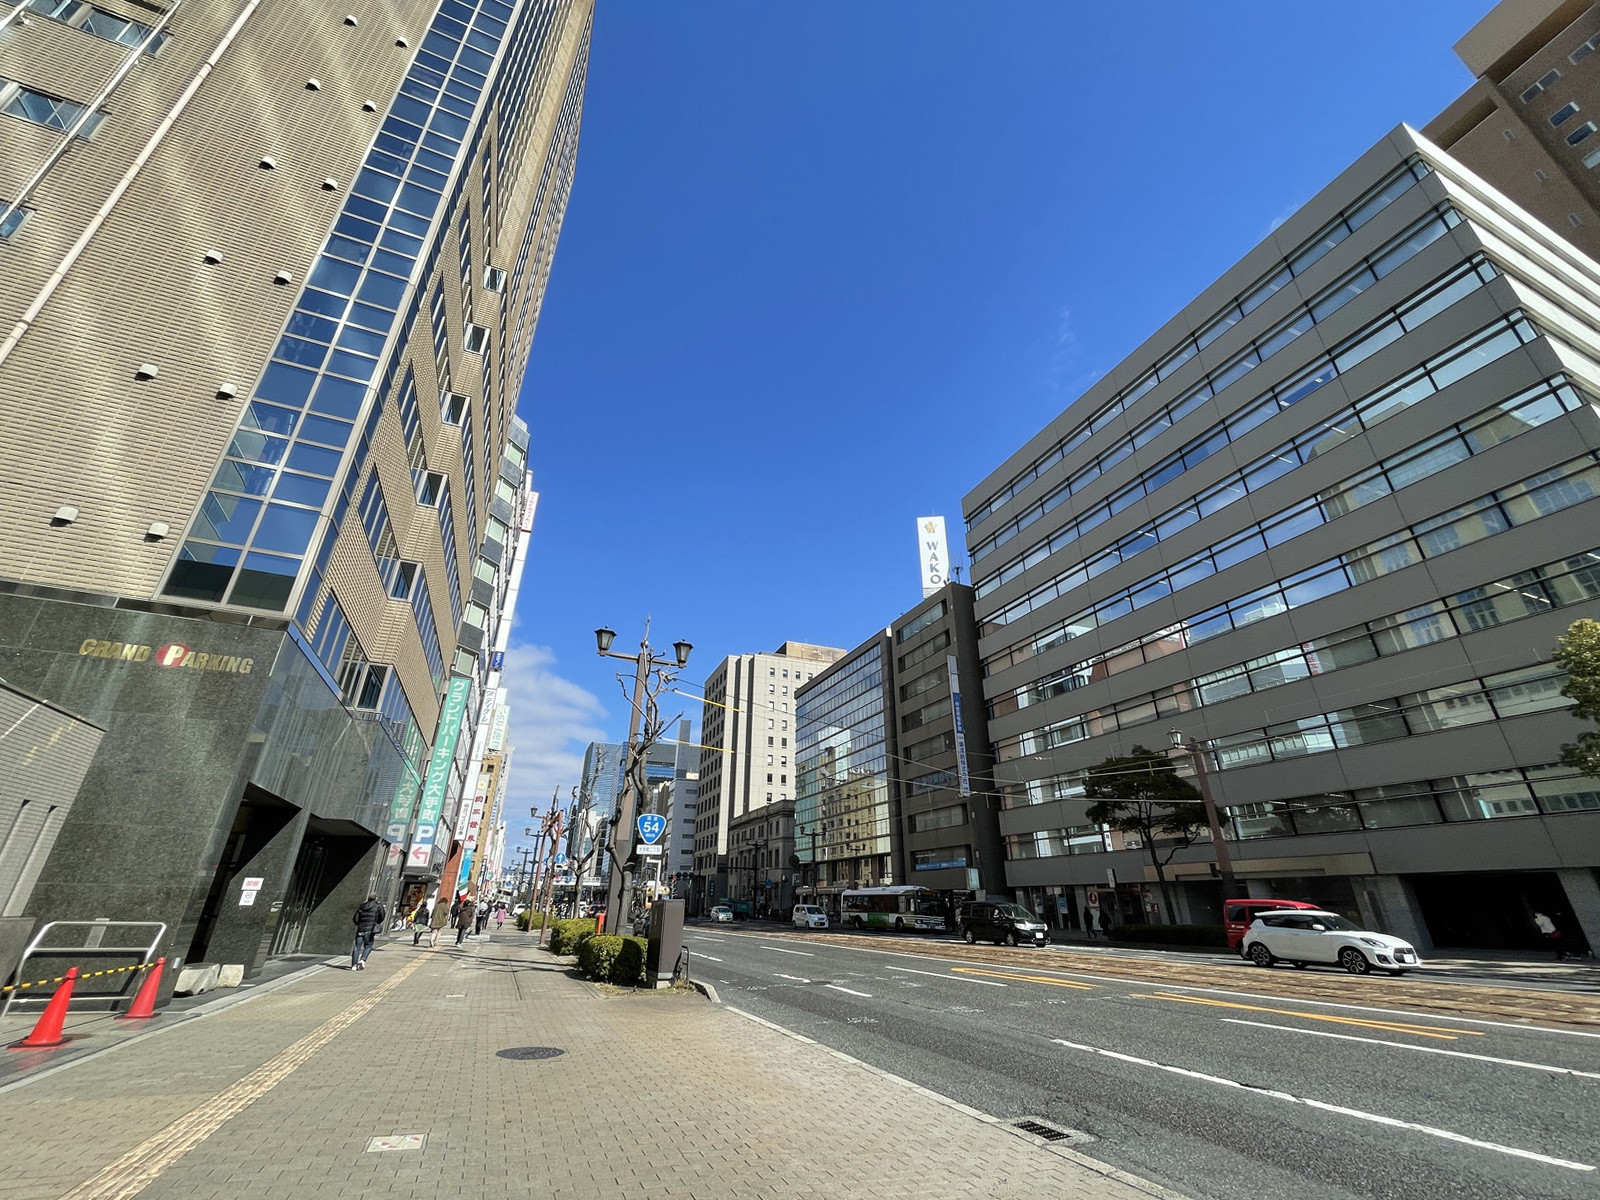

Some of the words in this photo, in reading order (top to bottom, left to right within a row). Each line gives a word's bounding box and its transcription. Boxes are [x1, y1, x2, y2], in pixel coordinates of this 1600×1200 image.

[926, 541, 942, 584] WAKO
[79, 638, 152, 662] GRAND
[162, 645, 254, 674] PARKING
[421, 680, 466, 821] グランドパーキング大手町
[415, 825, 434, 842] P
[643, 821, 660, 833] 54
